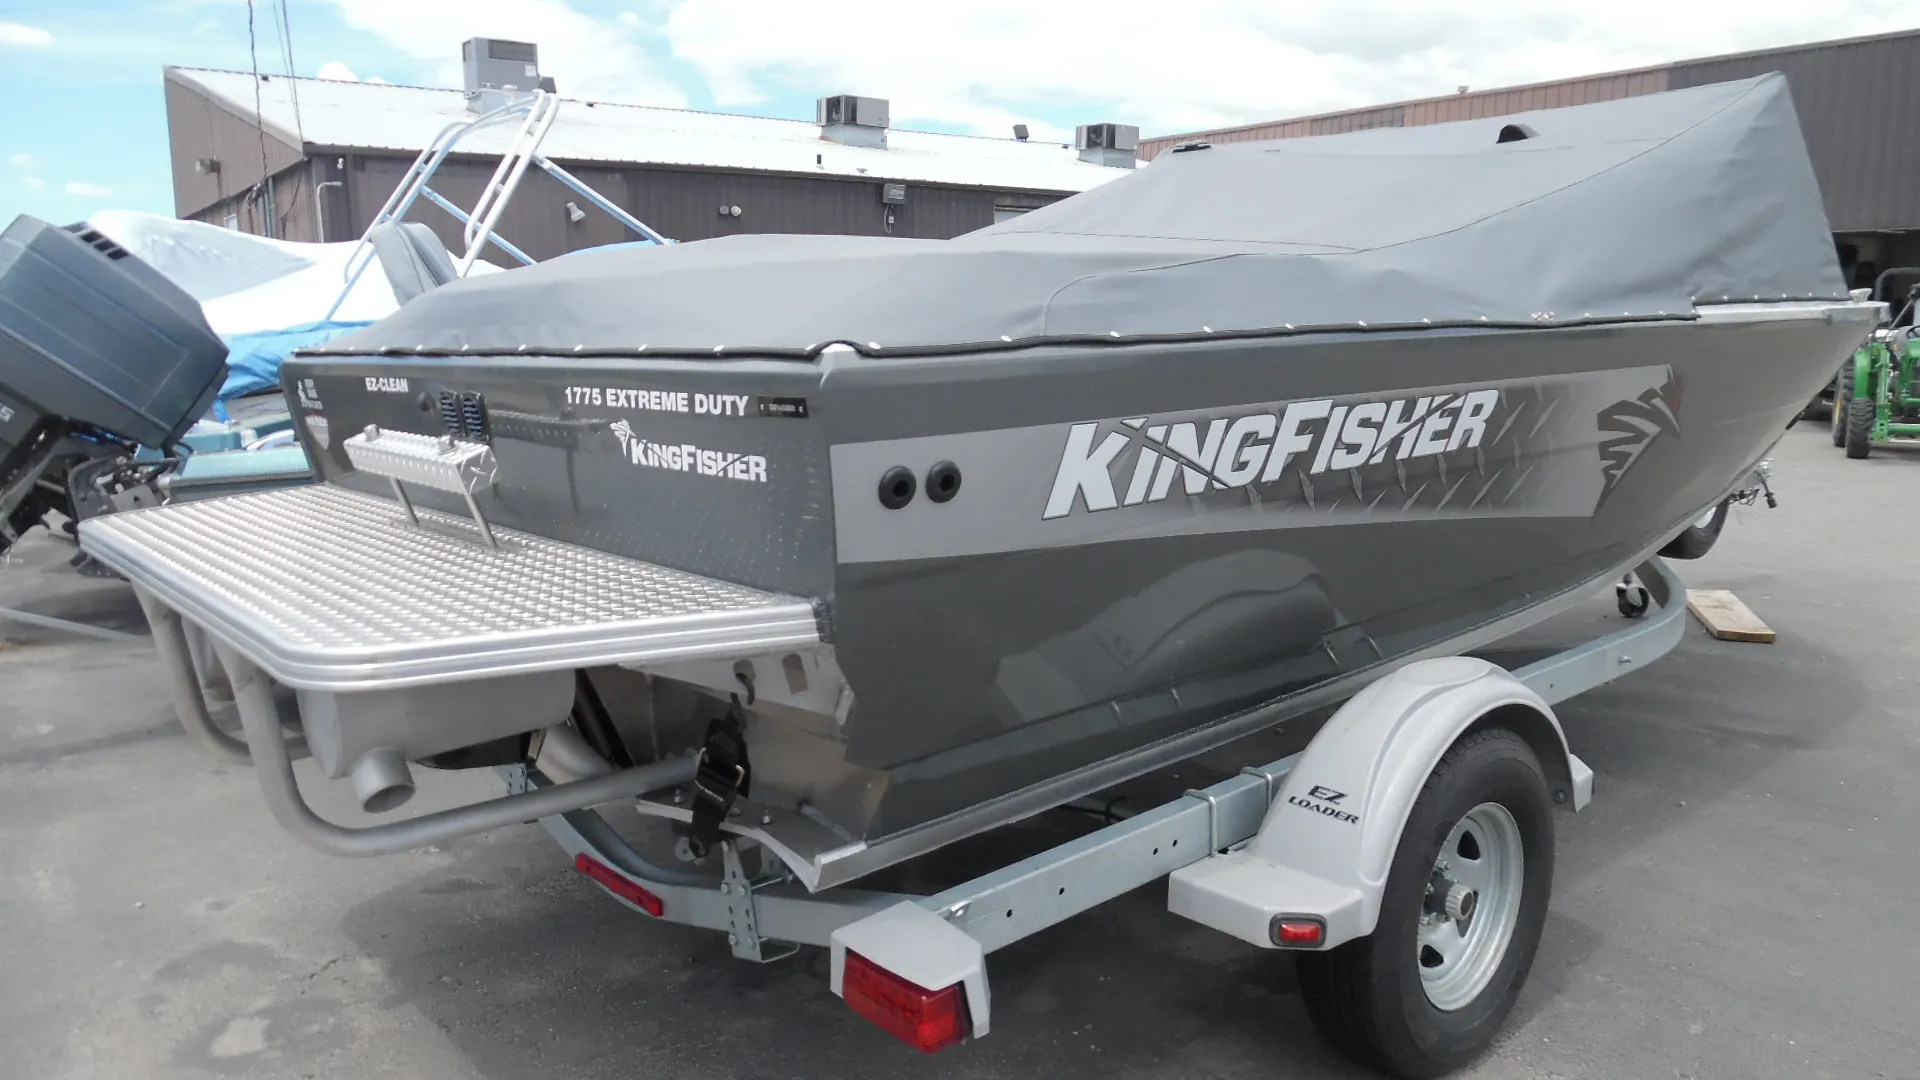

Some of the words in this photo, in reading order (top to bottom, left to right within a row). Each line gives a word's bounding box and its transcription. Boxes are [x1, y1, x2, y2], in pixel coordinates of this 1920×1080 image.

[365, 377, 409, 393] EZ-CLEAN
[564, 386, 602, 406] 1775
[605, 388, 689, 413] EXTREME
[694, 393, 749, 417] DUTY
[1308, 784, 1348, 806] EZ
[1288, 796, 1360, 825] LOADER
